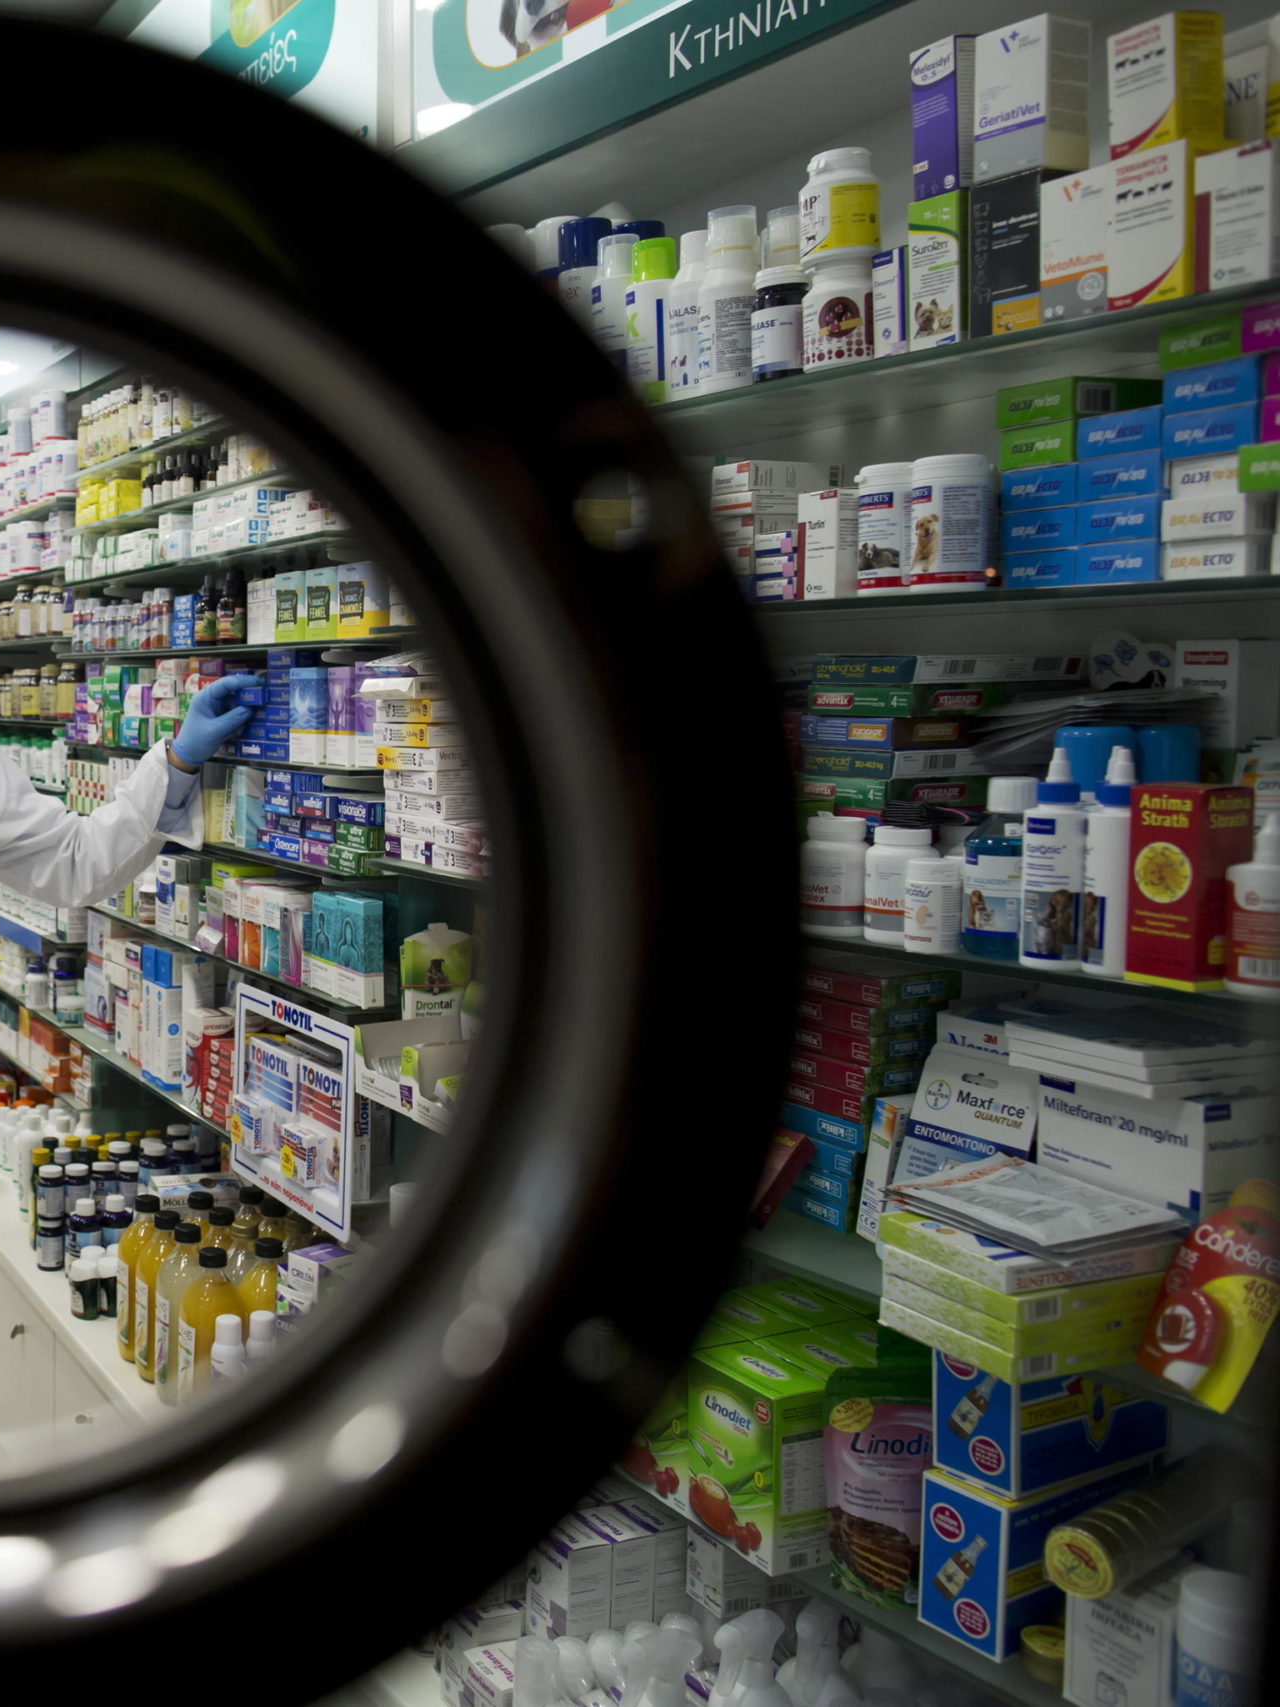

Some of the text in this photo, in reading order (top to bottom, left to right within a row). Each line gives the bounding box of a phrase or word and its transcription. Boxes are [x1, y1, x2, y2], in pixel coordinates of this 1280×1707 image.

[913, 54, 951, 76] Meloxidyl
[978, 102, 1040, 128] GeriatiVet
[1175, 376, 1238, 400] BRAVECTO
[1088, 424, 1144, 444] BRAVECTO
[1174, 423, 1236, 444] BRAVECTO
[1011, 479, 1061, 497] BRAVECTO
[1169, 509, 1235, 526] BRAVECTO
[1011, 522, 1061, 539] BRAVECTO
[1170, 552, 1235, 569] BRAVECTO
[1012, 563, 1061, 579] BRAVECTO
[1182, 677, 1227, 690] Worming
[1140, 793, 1194, 812] Anima
[1208, 795, 1251, 812] Anima
[1141, 810, 1190, 829] Strath
[416, 999, 453, 1011] Drontal
[271, 1000, 313, 1032] TONOTIL
[984, 1033, 998, 1045] 3M
[252, 1045, 289, 1077] TONOTIL
[956, 1089, 1026, 1119] Maxforce
[973, 1110, 1024, 1130] QUANTUM
[1043, 1095, 1189, 1149] Milteforan 20 mg/ml
[254, 1117, 262, 1150] TONOTIL
[913, 1124, 996, 1156] ΕΝΤΟΜΟΚΤΟΝΟ
[306, 1148, 314, 1180] TONOTIL
[704, 1394, 752, 1432] Linodiet
